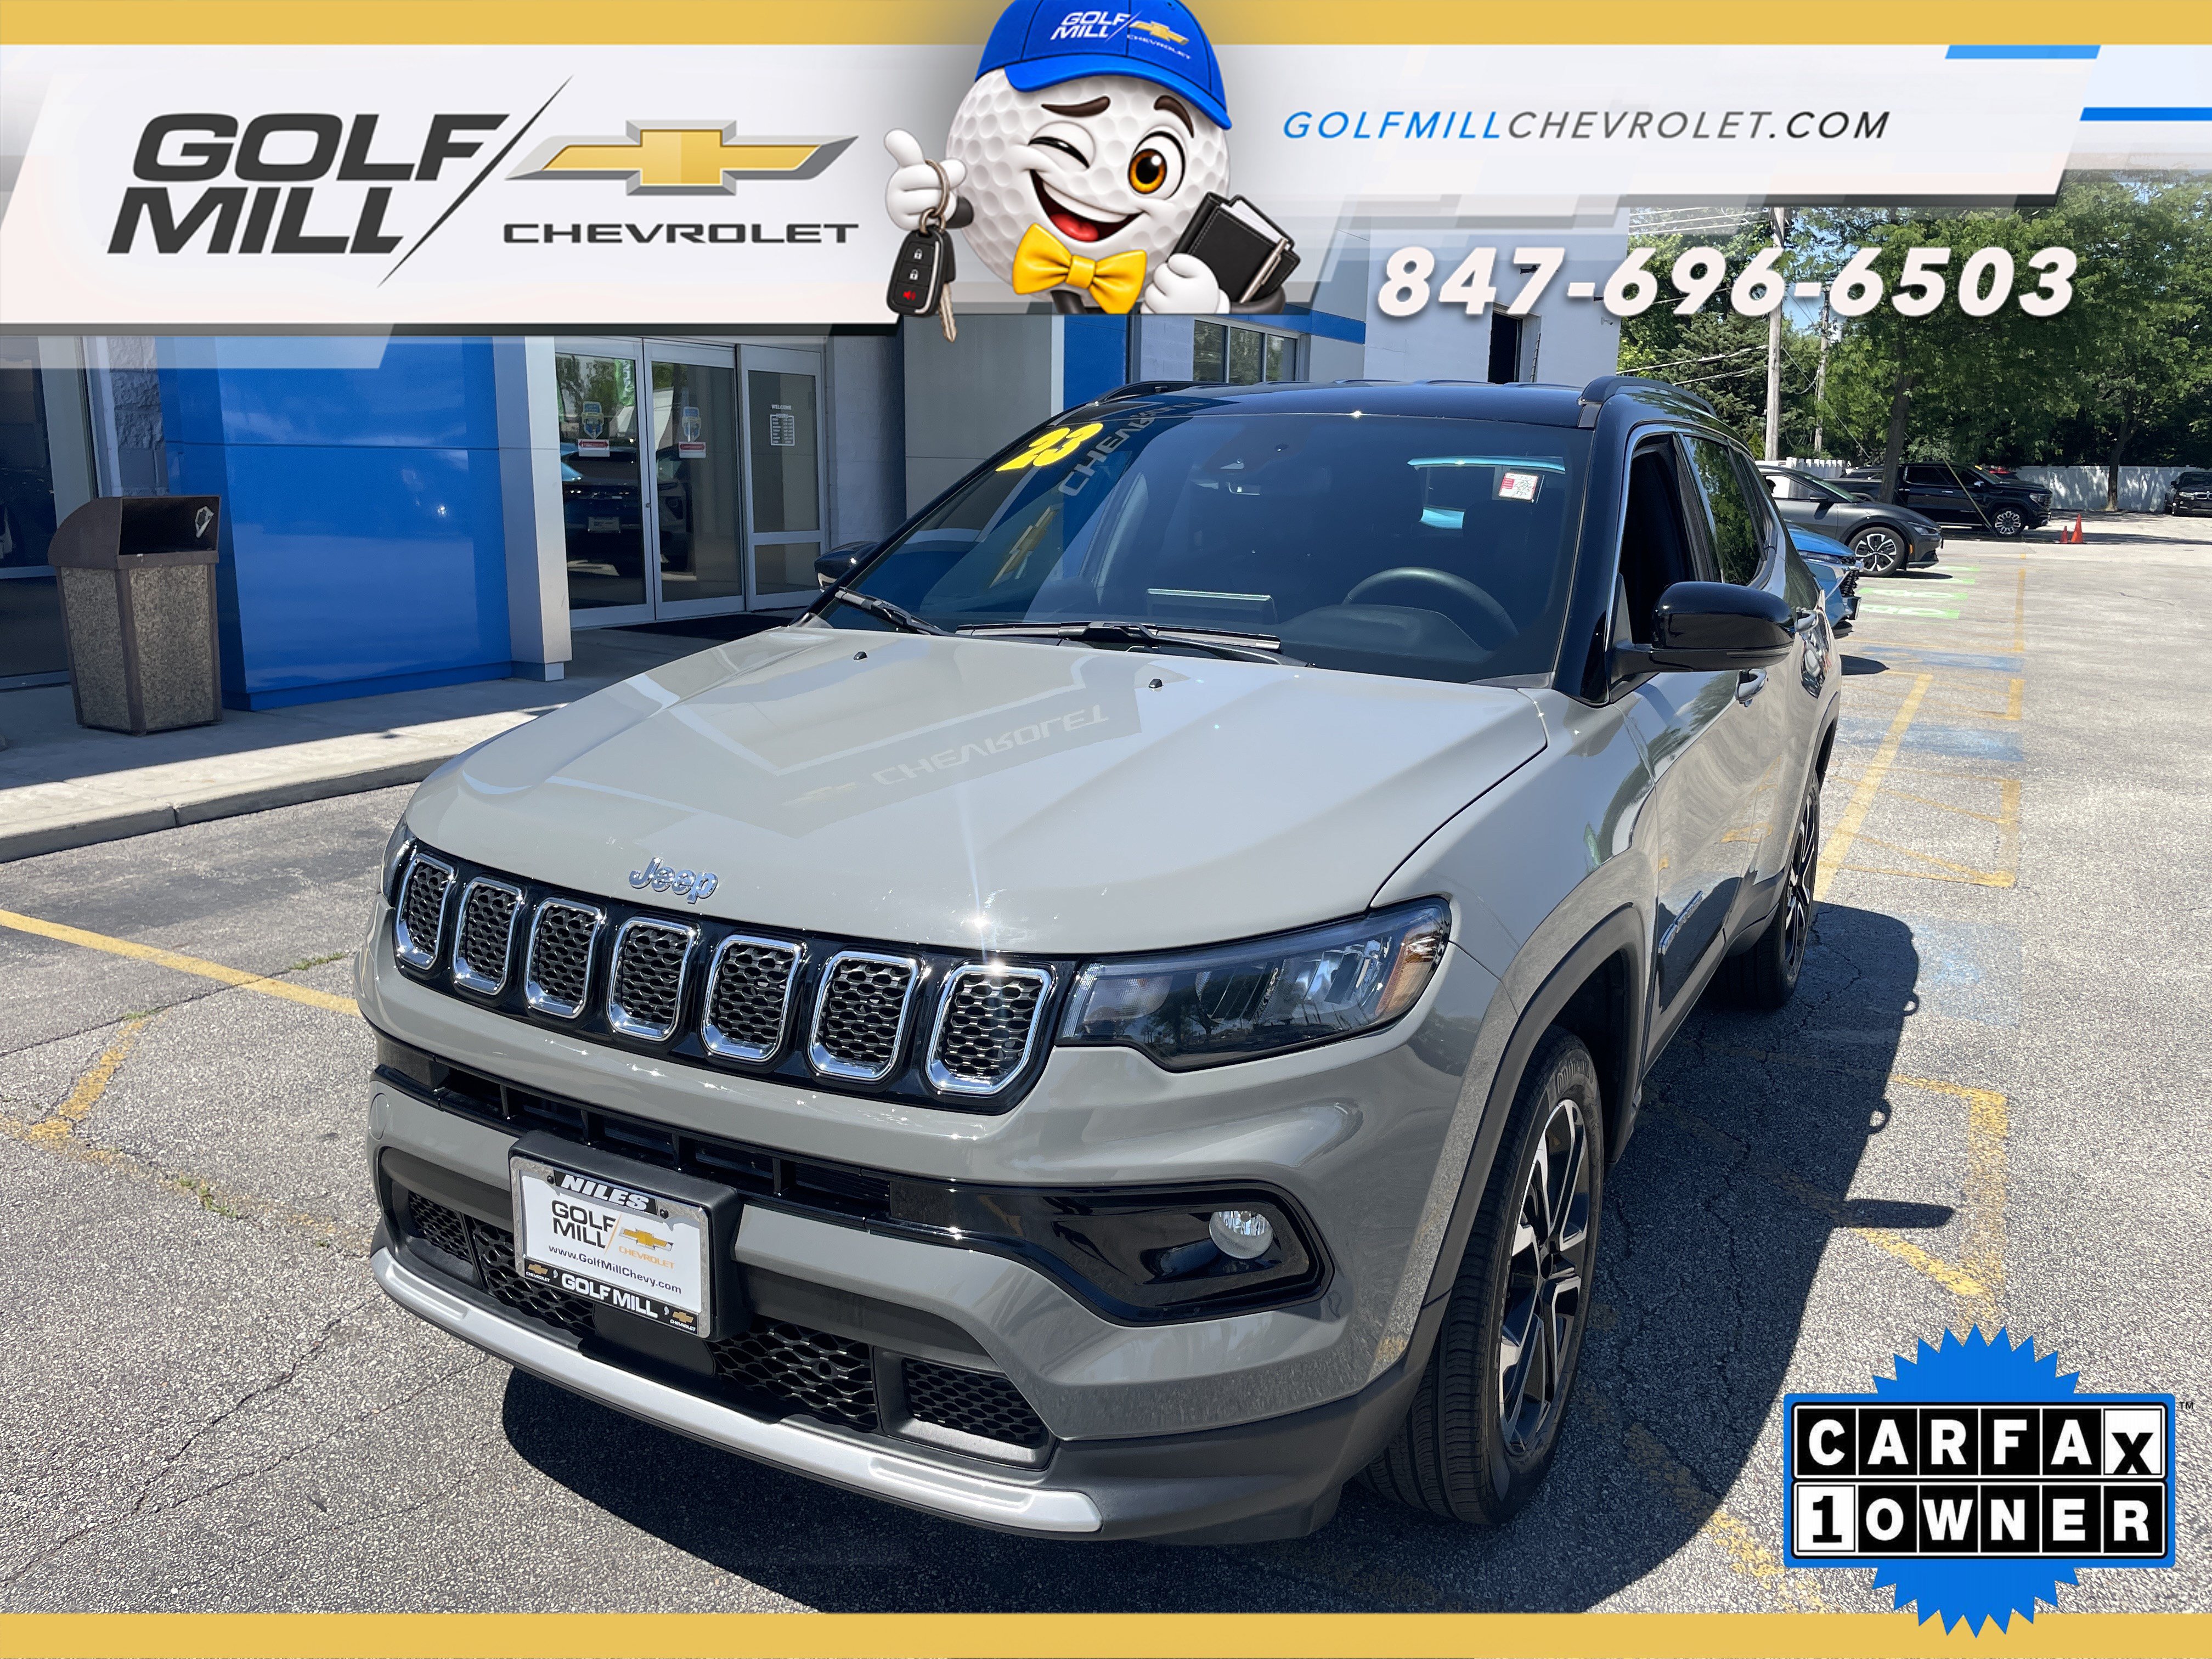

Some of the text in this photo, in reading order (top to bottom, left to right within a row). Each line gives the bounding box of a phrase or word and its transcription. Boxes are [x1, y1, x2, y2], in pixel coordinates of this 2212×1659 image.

[995, 422, 1104, 472] 23
[628, 857, 719, 904] Jeep
[561, 1174, 650, 1211] NILES
[551, 1199, 617, 1233] GOLF
[552, 1216, 606, 1249] MILL
[548, 1244, 682, 1294] www.GolfMillChevy.com
[618, 1245, 675, 1269] CHEVROLET
[526, 1271, 551, 1283] CHEVROLET
[561, 1273, 658, 1319] GOLF MILL
[669, 1319, 697, 1332] CHEVROLET
